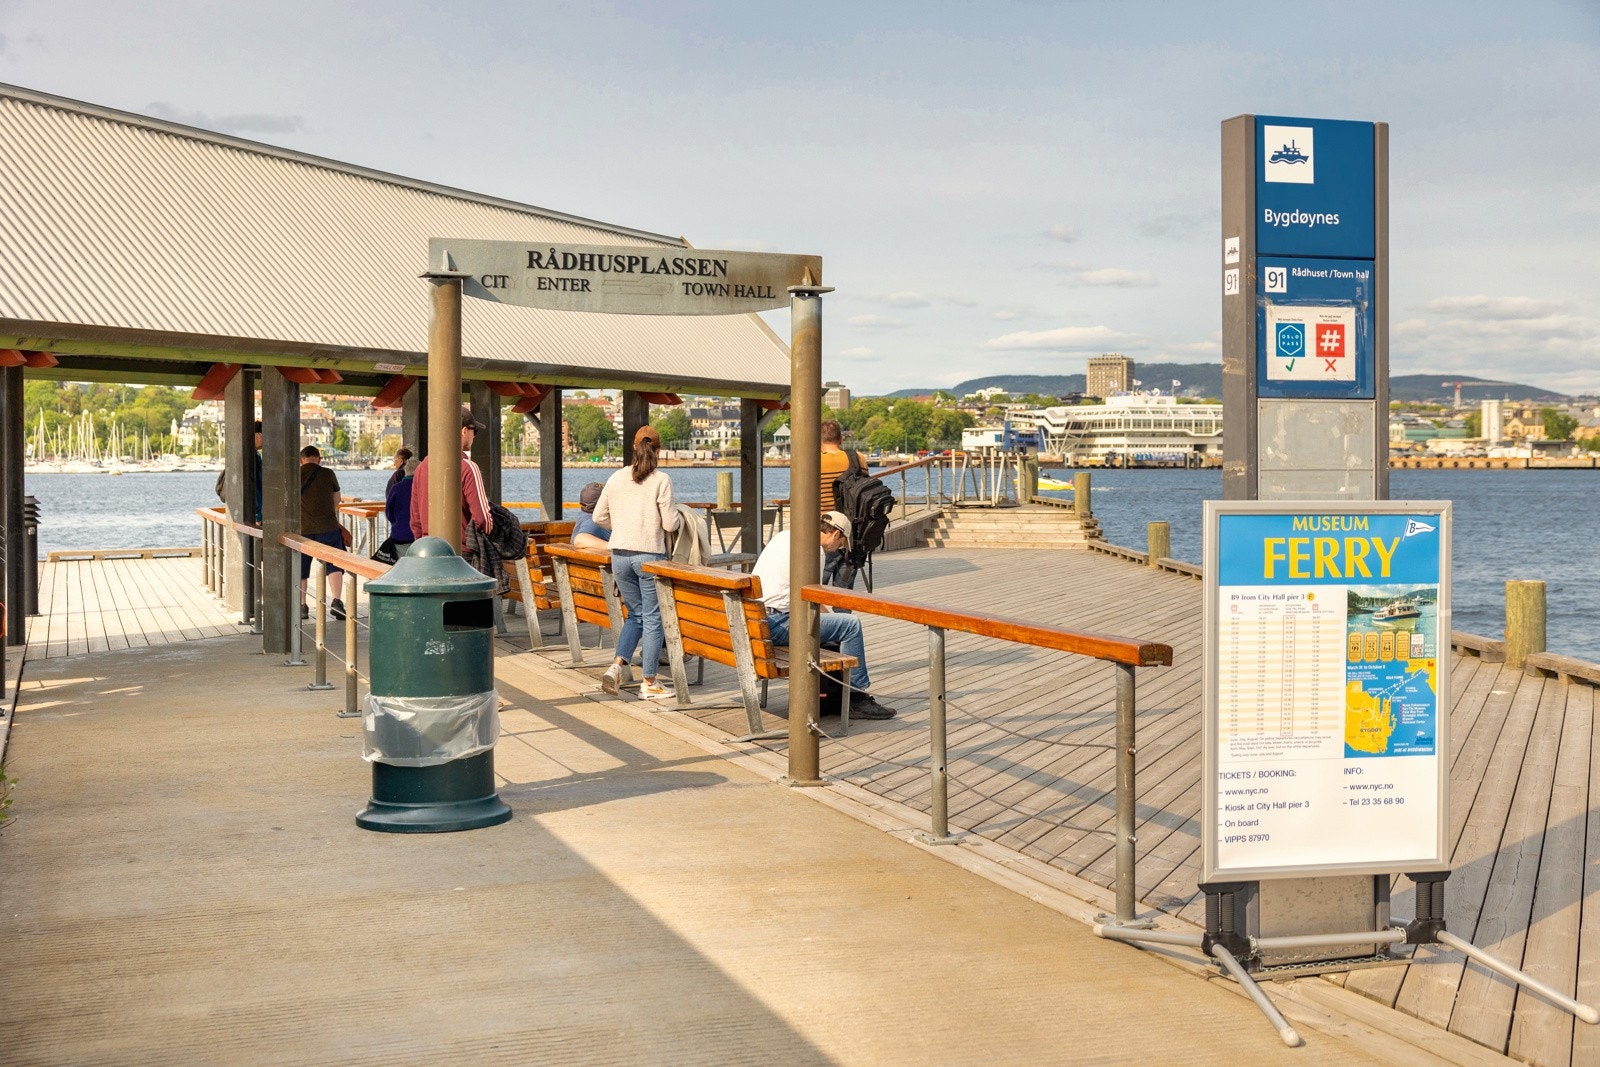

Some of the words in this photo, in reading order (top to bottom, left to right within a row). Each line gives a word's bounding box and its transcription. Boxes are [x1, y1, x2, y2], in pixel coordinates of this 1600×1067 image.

[1264, 208, 1340, 228] Bygdøynes
[526, 247, 729, 277] RÅDHUSPLASSEN
[1292, 267, 1328, 278] Rådhuset
[1226, 274, 1237, 291] 91
[1268, 271, 1284, 289] 91
[682, 282, 730, 296] TOWN
[734, 284, 776, 299] HALL
[1292, 515, 1370, 531] MUSEUM
[1263, 536, 1401, 579] FERRY
[1241, 593, 1257, 601] from
[1258, 593, 1270, 602] City
[1272, 593, 1286, 601] Hall
[1286, 593, 1299, 602] pier
[1219, 771, 1251, 780] TICKETS
[1258, 769, 1297, 779] BOOKING:
[1343, 767, 1364, 775] INFO:
[1225, 787, 1269, 796] www.nyc.no
[1349, 783, 1394, 792] www.nyc.no
[1225, 803, 1246, 812] Kiosk
[1247, 803, 1254, 811] at
[1256, 802, 1271, 811] City
[1272, 801, 1287, 810] Hall
[1288, 801, 1303, 810] pier
[1304, 800, 1310, 808] 3
[1349, 798, 1360, 806] Tel
[1361, 798, 1371, 806] 23
[1372, 797, 1382, 805] 35
[1383, 797, 1393, 805] 68
[1395, 797, 1405, 805] 90
[1225, 819, 1236, 828] On
[1237, 818, 1259, 827] board
[1225, 835, 1247, 843] VIPPS
[1248, 833, 1270, 842] 87970
